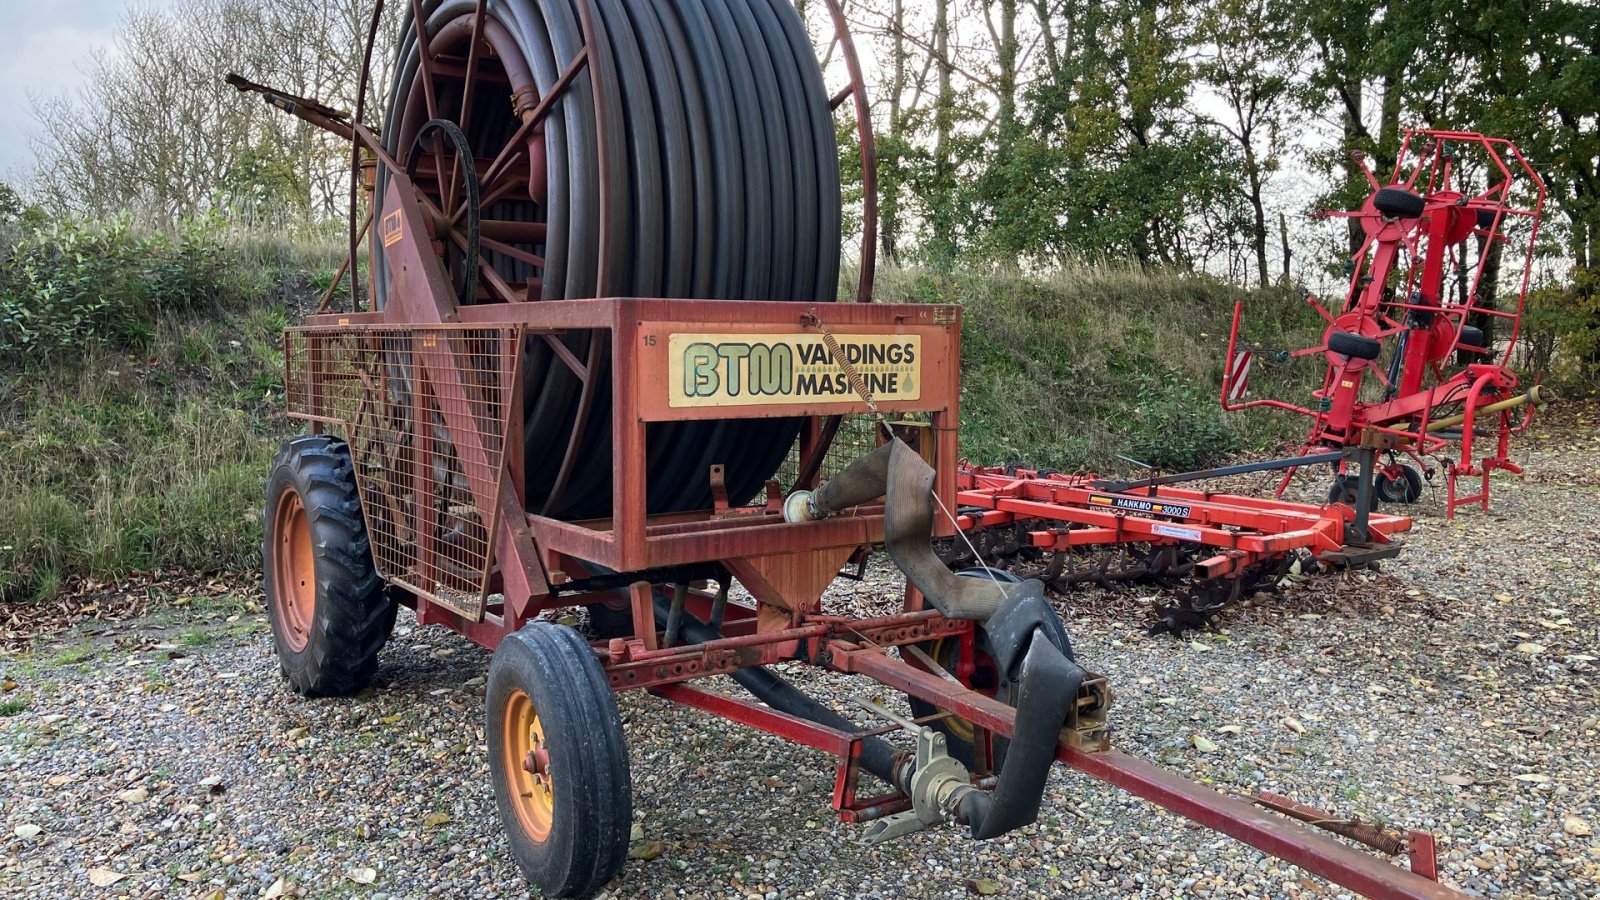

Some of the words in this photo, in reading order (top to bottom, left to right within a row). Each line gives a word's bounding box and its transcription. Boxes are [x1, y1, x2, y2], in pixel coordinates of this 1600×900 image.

[642, 335, 656, 346] 15
[683, 342, 793, 397] BTM
[1117, 498, 1151, 510] HANKMO
